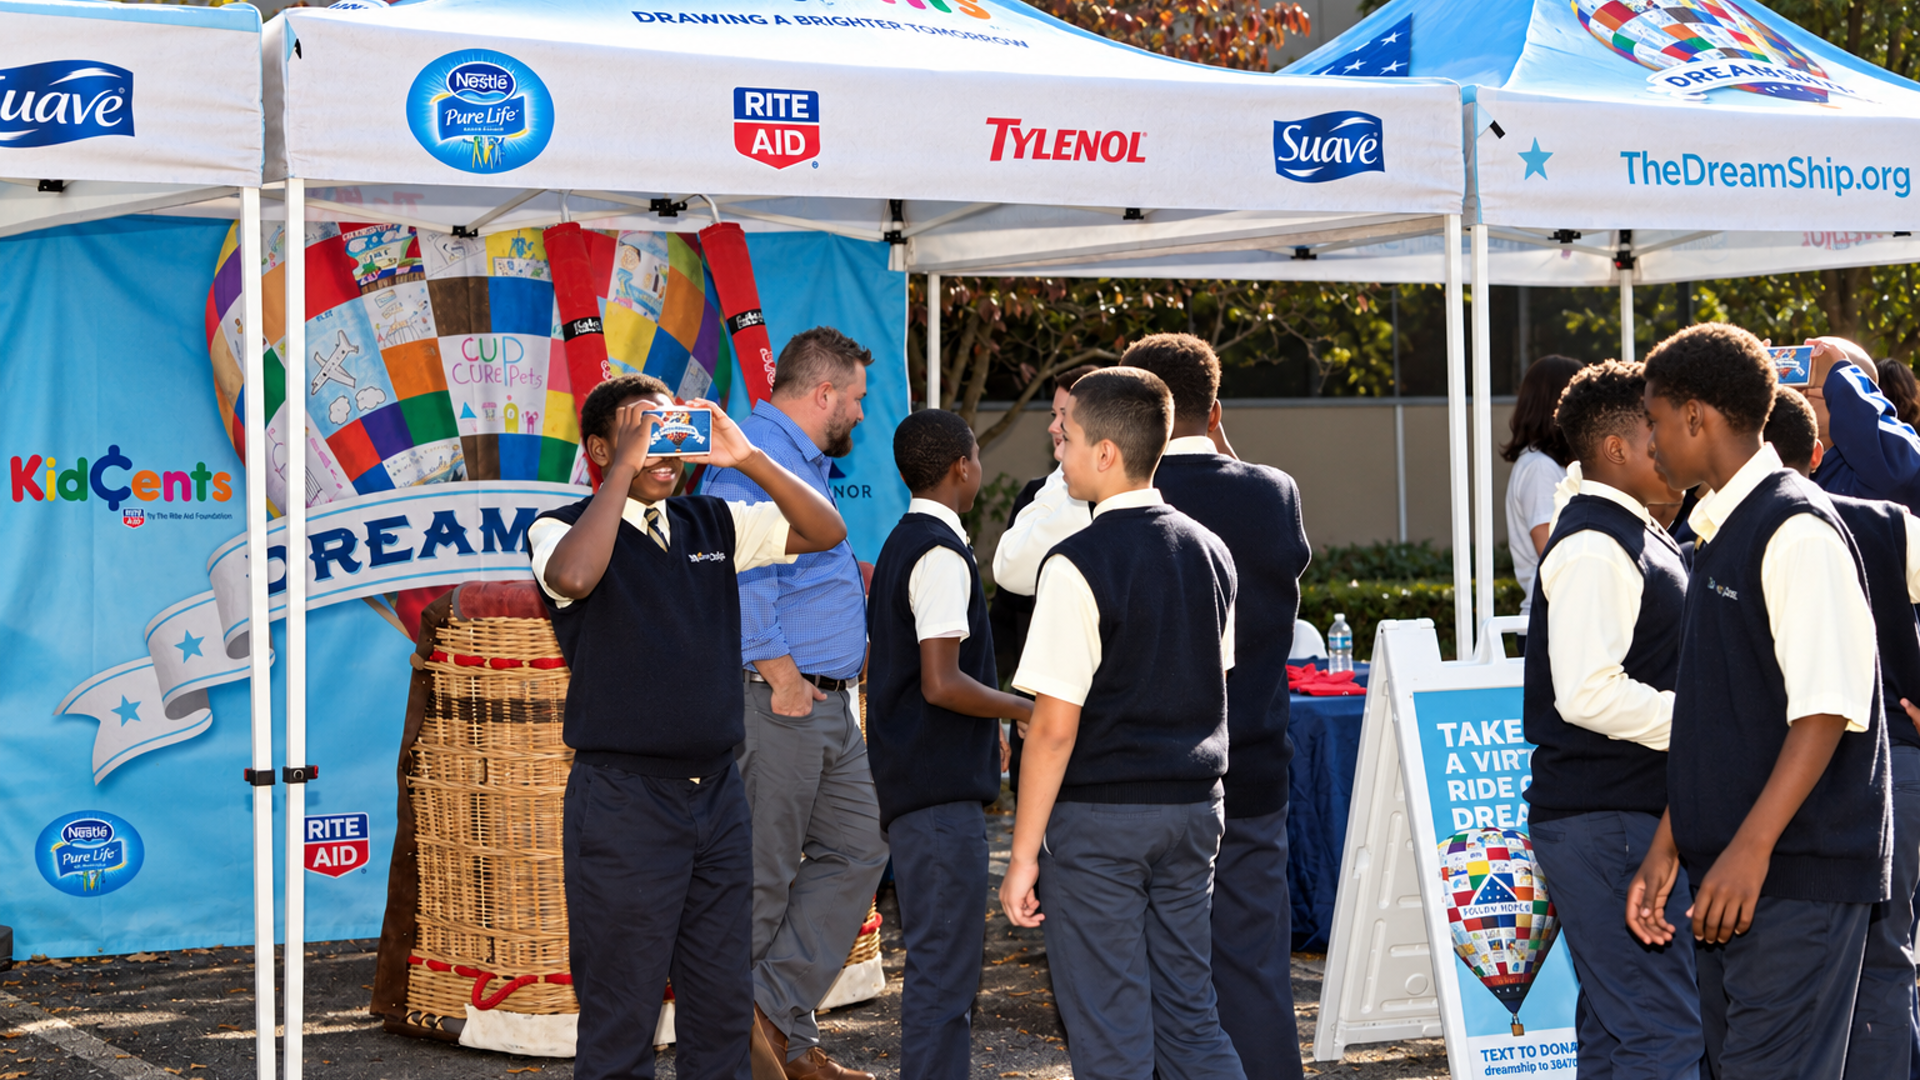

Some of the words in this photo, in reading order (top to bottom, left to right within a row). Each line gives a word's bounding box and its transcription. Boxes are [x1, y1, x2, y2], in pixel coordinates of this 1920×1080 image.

[631, 11, 768, 25] DRAWING
[774, 14, 792, 26] A
[793, 15, 906, 31] BRIGHTER
[904, 22, 1030, 49] TOMORROW
[0, 74, 124, 128] uave
[744, 91, 810, 119] RITE
[445, 108, 485, 126] Pure
[486, 106, 516, 126] Life
[750, 128, 807, 156] AID
[985, 117, 1147, 163] TYLENOL
[1277, 124, 1378, 165] Suave
[1619, 150, 1912, 198] TheDreamShip.org
[829, 484, 872, 499] NOR
[1436, 719, 1524, 748] TAKE
[1445, 752, 1467, 775] A
[1447, 776, 1516, 802] RIDE
[308, 817, 360, 840] RITE
[62, 853, 91, 866] Pure
[93, 847, 115, 862] Life
[312, 845, 358, 868] AID
[1480, 1047, 1515, 1062] TEXT
[1517, 1045, 1537, 1059] TO
[1484, 1061, 1537, 1076] dreamship
[1538, 1062, 1549, 1071] to
